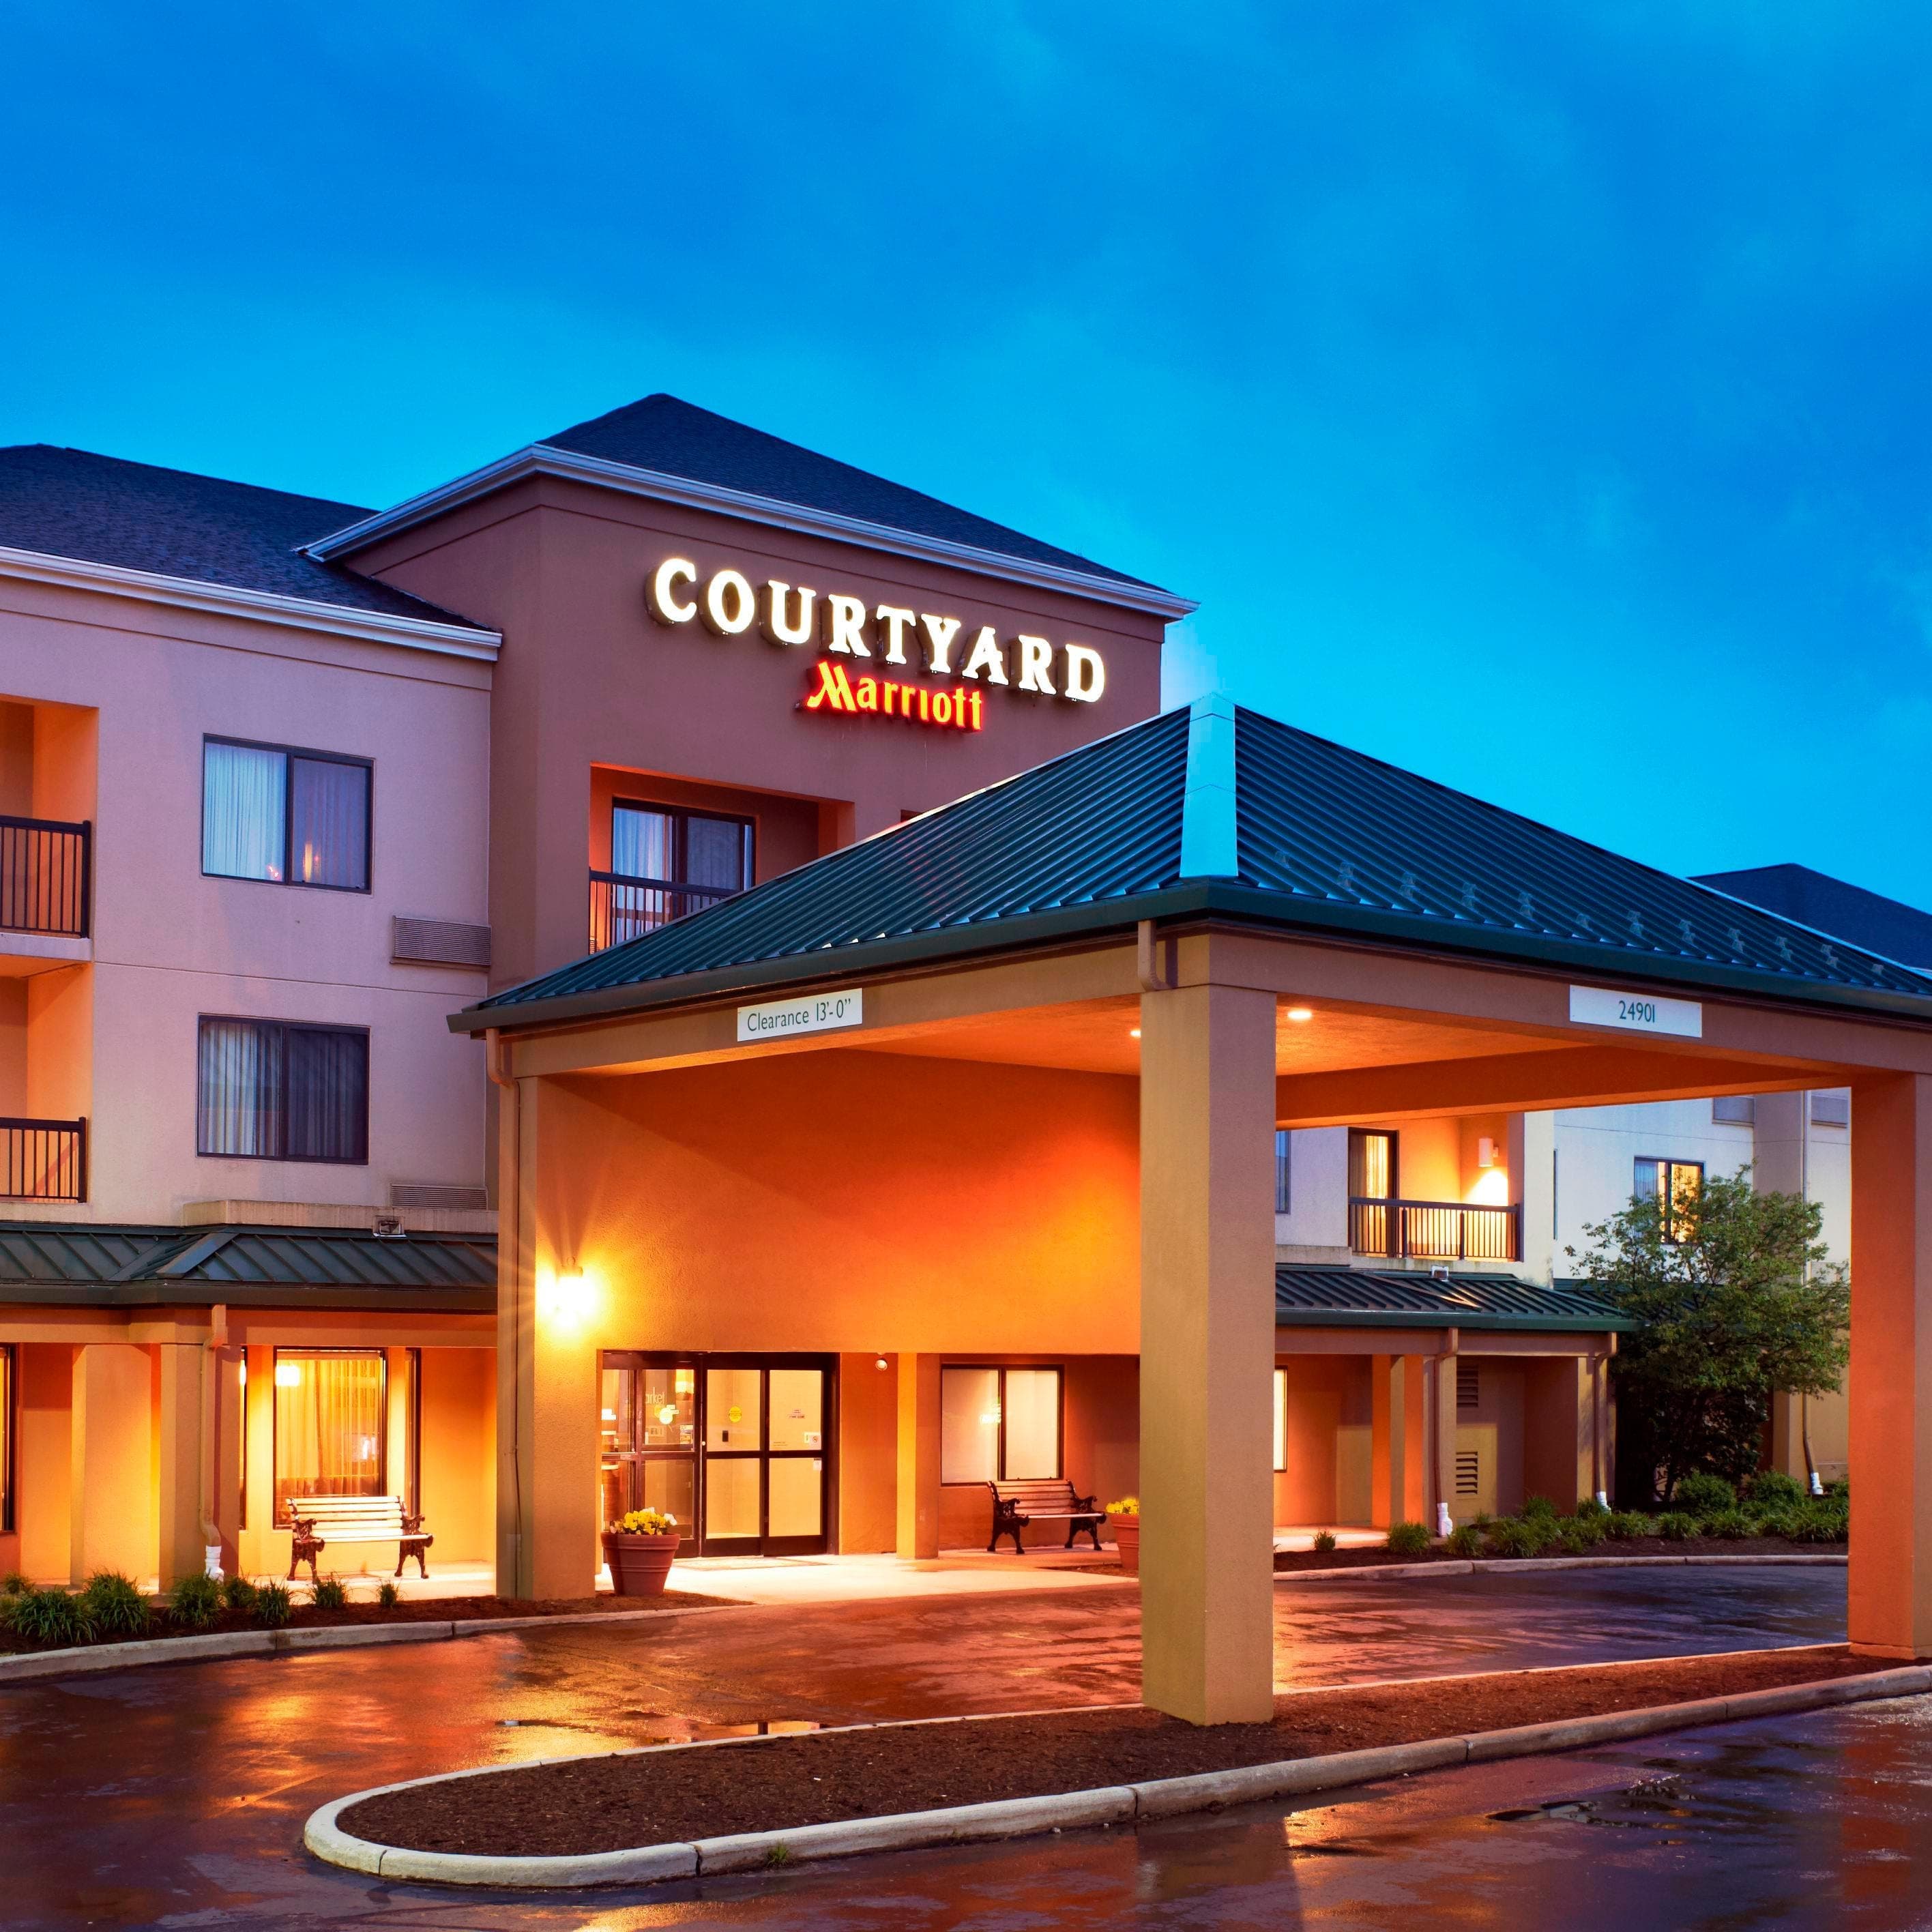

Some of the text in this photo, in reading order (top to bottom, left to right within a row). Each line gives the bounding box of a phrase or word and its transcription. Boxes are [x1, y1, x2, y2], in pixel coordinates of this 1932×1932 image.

[654, 557, 1105, 703] COURTYARD
[806, 660, 983, 731] Marriott
[747, 1010, 809, 1031] Clearance
[1618, 999, 1656, 1023] 24901
